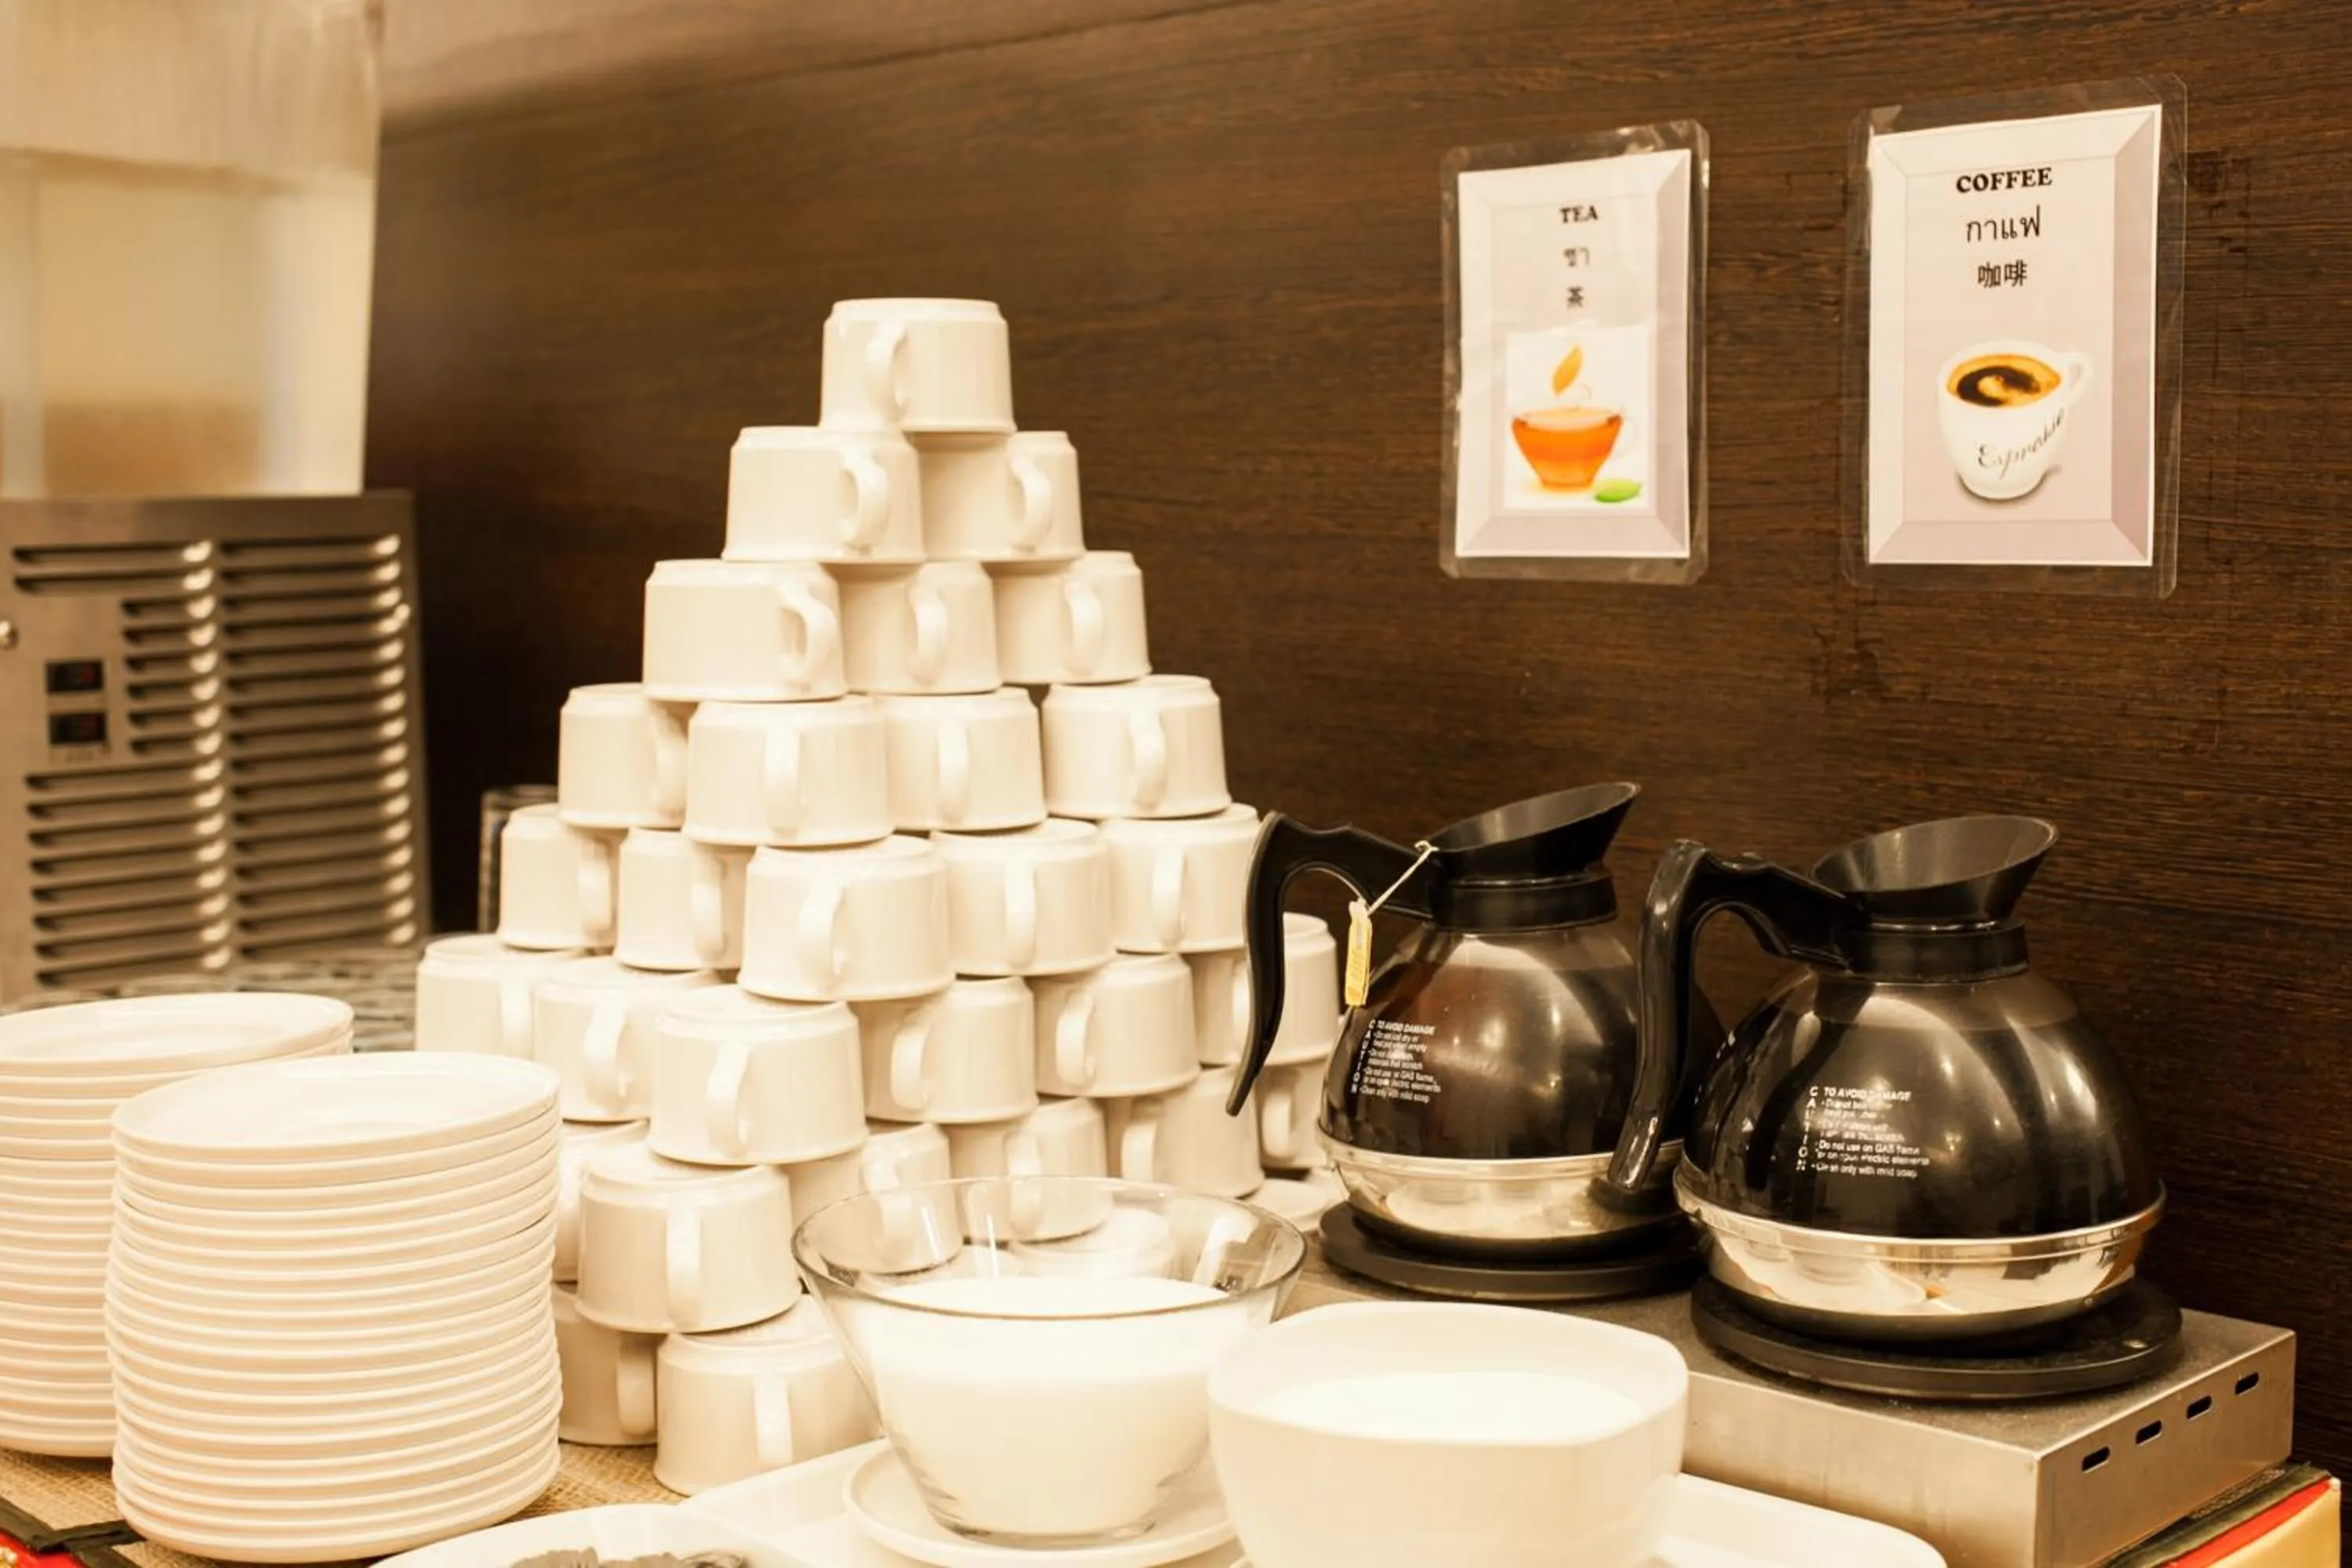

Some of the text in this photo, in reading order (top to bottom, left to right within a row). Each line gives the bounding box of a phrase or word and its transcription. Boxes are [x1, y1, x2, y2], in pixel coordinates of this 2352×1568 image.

[1956, 167, 2053, 193] COFFEE
[1559, 205, 1599, 224] TEA
[1966, 204, 2041, 242] กาแฟ
[1977, 260, 2028, 289] 咖啡
[1824, 1087, 1836, 1097] TO
